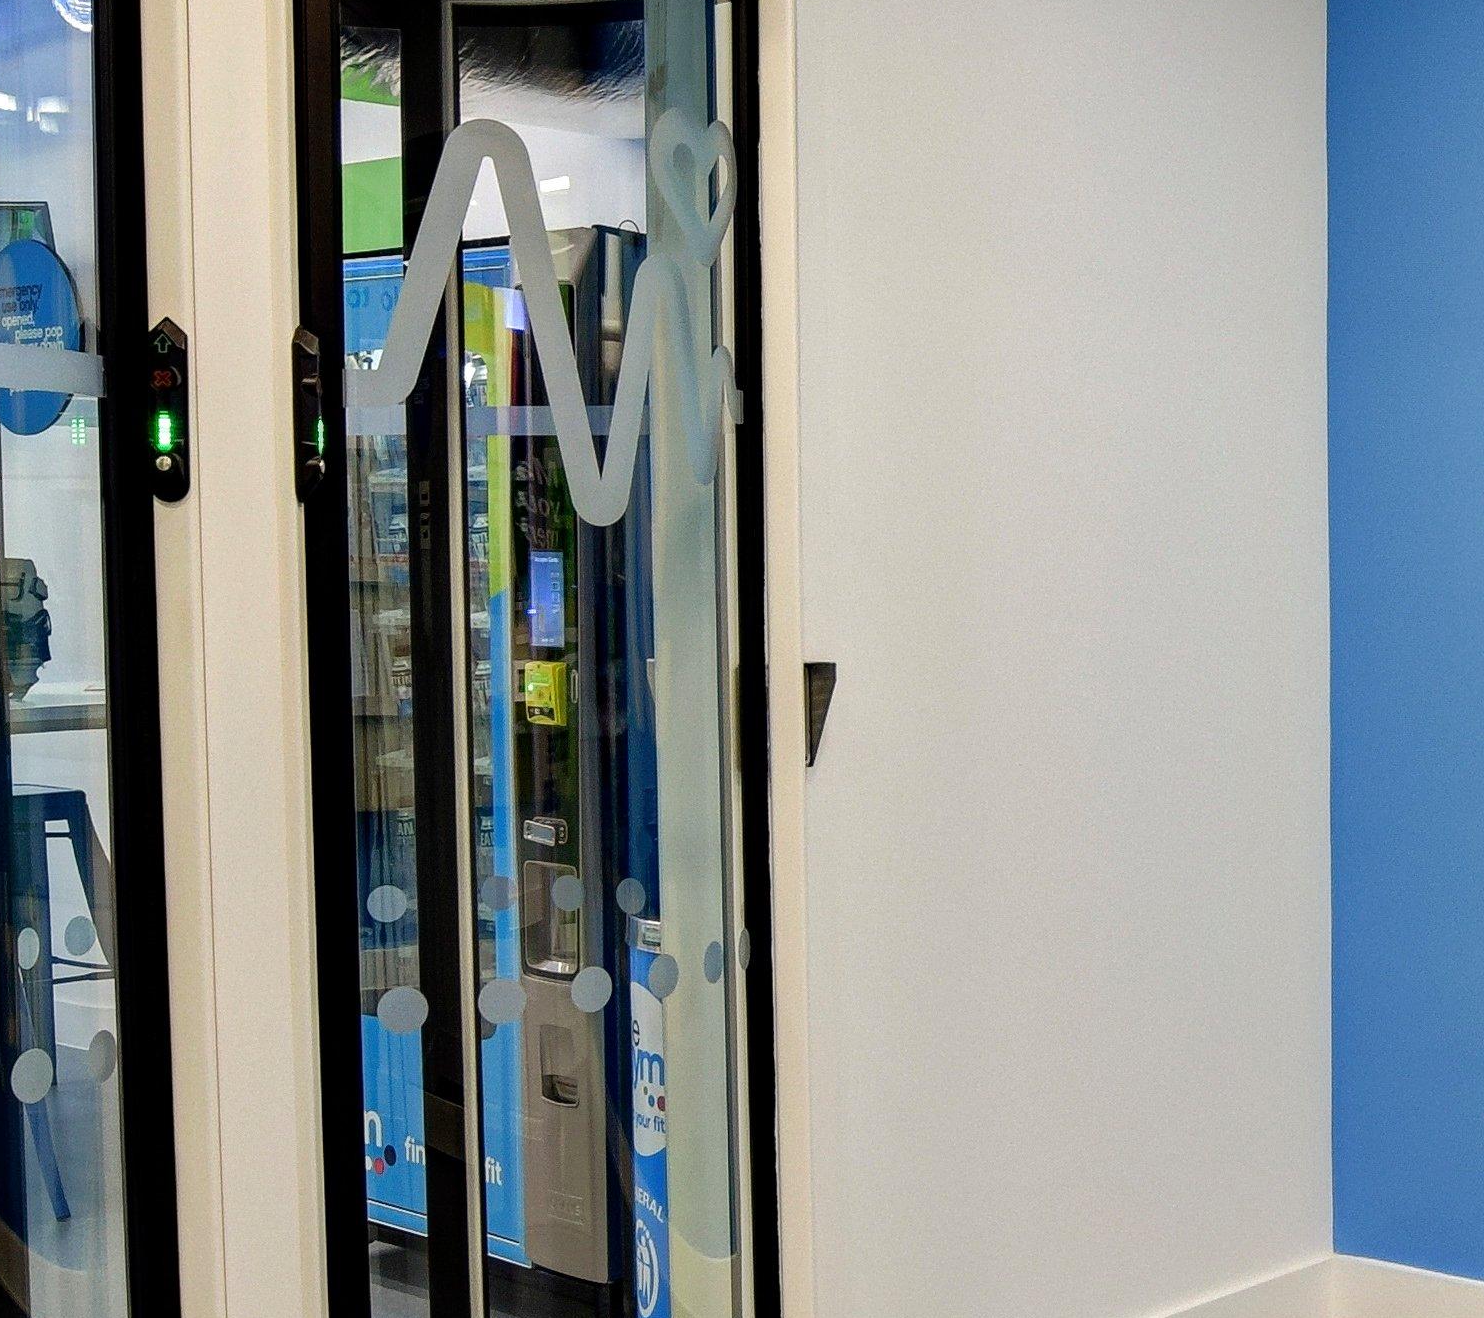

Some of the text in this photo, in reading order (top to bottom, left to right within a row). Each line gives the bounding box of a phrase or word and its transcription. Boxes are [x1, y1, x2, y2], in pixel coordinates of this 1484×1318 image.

[15, 325, 63, 345] please pop
[654, 1116, 666, 1134] fit
